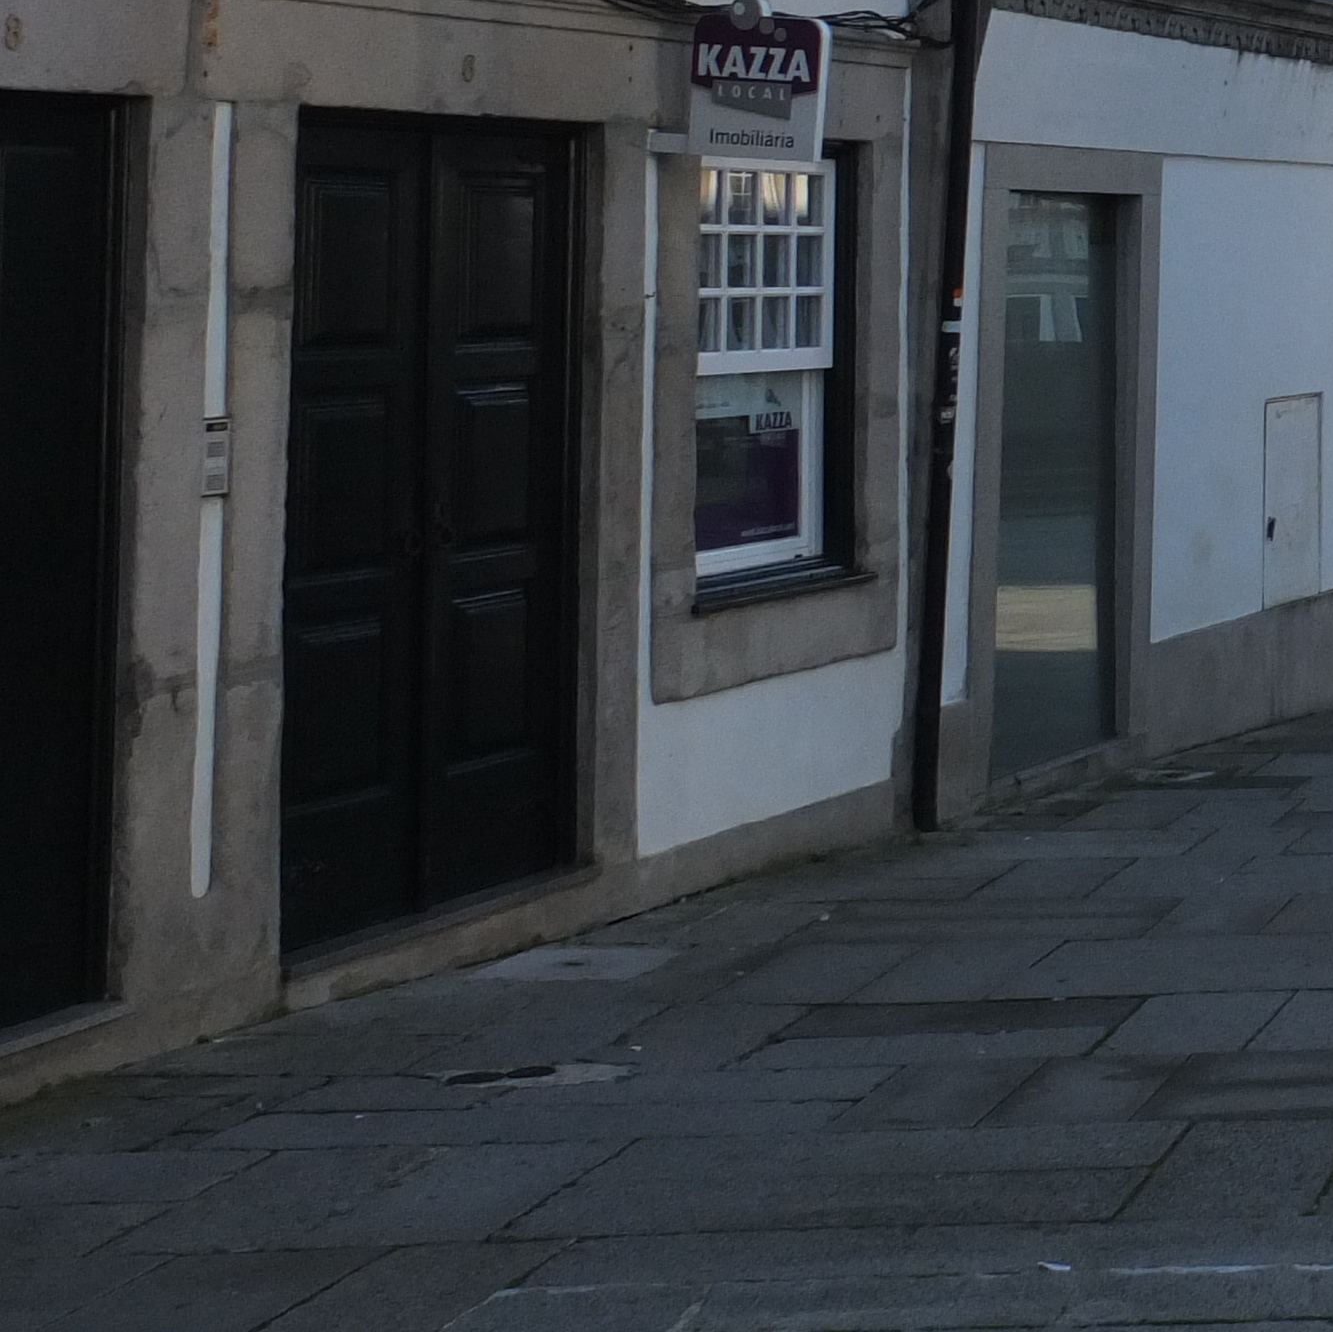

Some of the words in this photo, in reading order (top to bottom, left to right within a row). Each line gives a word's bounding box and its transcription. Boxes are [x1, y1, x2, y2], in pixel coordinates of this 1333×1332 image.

[697, 43, 810, 82] KAZZA
[717, 84, 787, 101] LOCAL
[709, 128, 795, 149] Imobiliária
[755, 411, 793, 431] KAZZA
